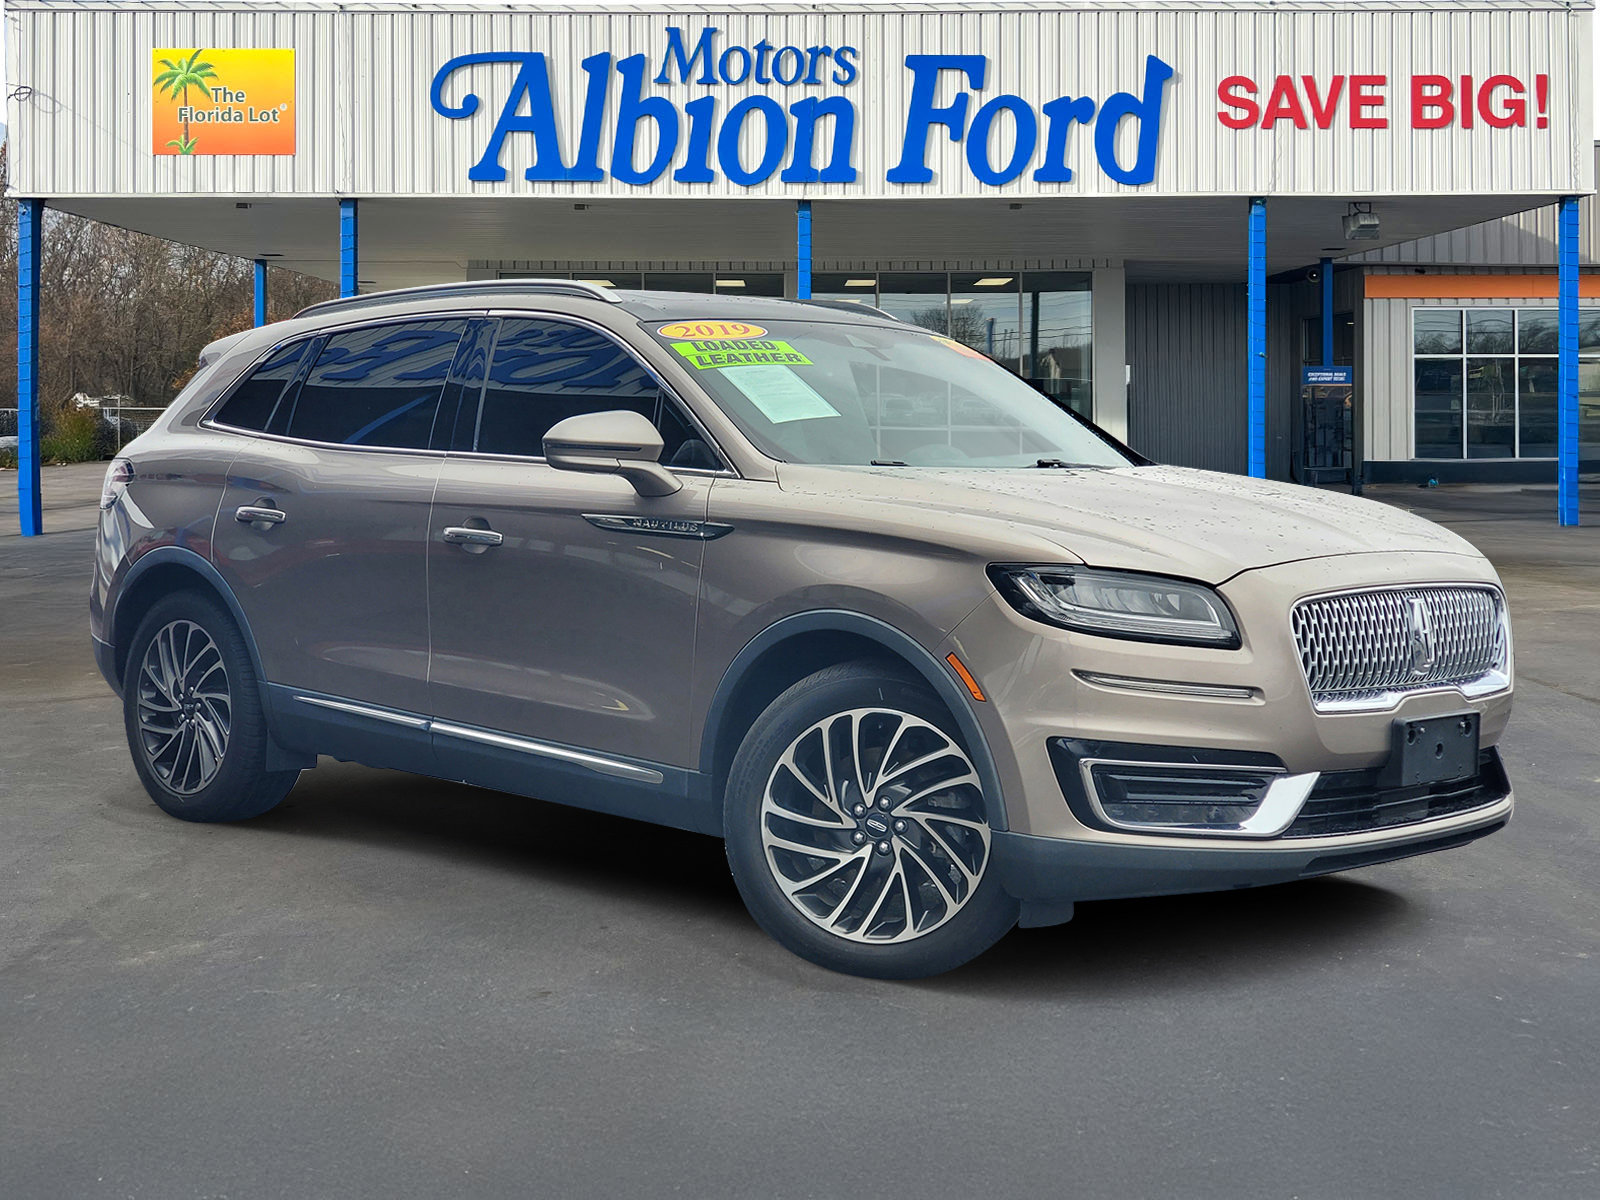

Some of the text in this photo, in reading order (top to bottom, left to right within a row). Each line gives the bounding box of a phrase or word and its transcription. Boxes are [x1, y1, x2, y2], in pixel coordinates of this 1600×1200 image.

[653, 26, 858, 87] Motors
[211, 87, 245, 103] The
[1216, 74, 1550, 130] SAVE BIG!
[178, 106, 243, 123] Florida
[429, 51, 1176, 186] Albion Ford
[674, 322, 751, 338] 2019
[690, 340, 780, 352] LOADED
[697, 351, 802, 367] LEATHER
[632, 517, 699, 533] NAUTILUS
